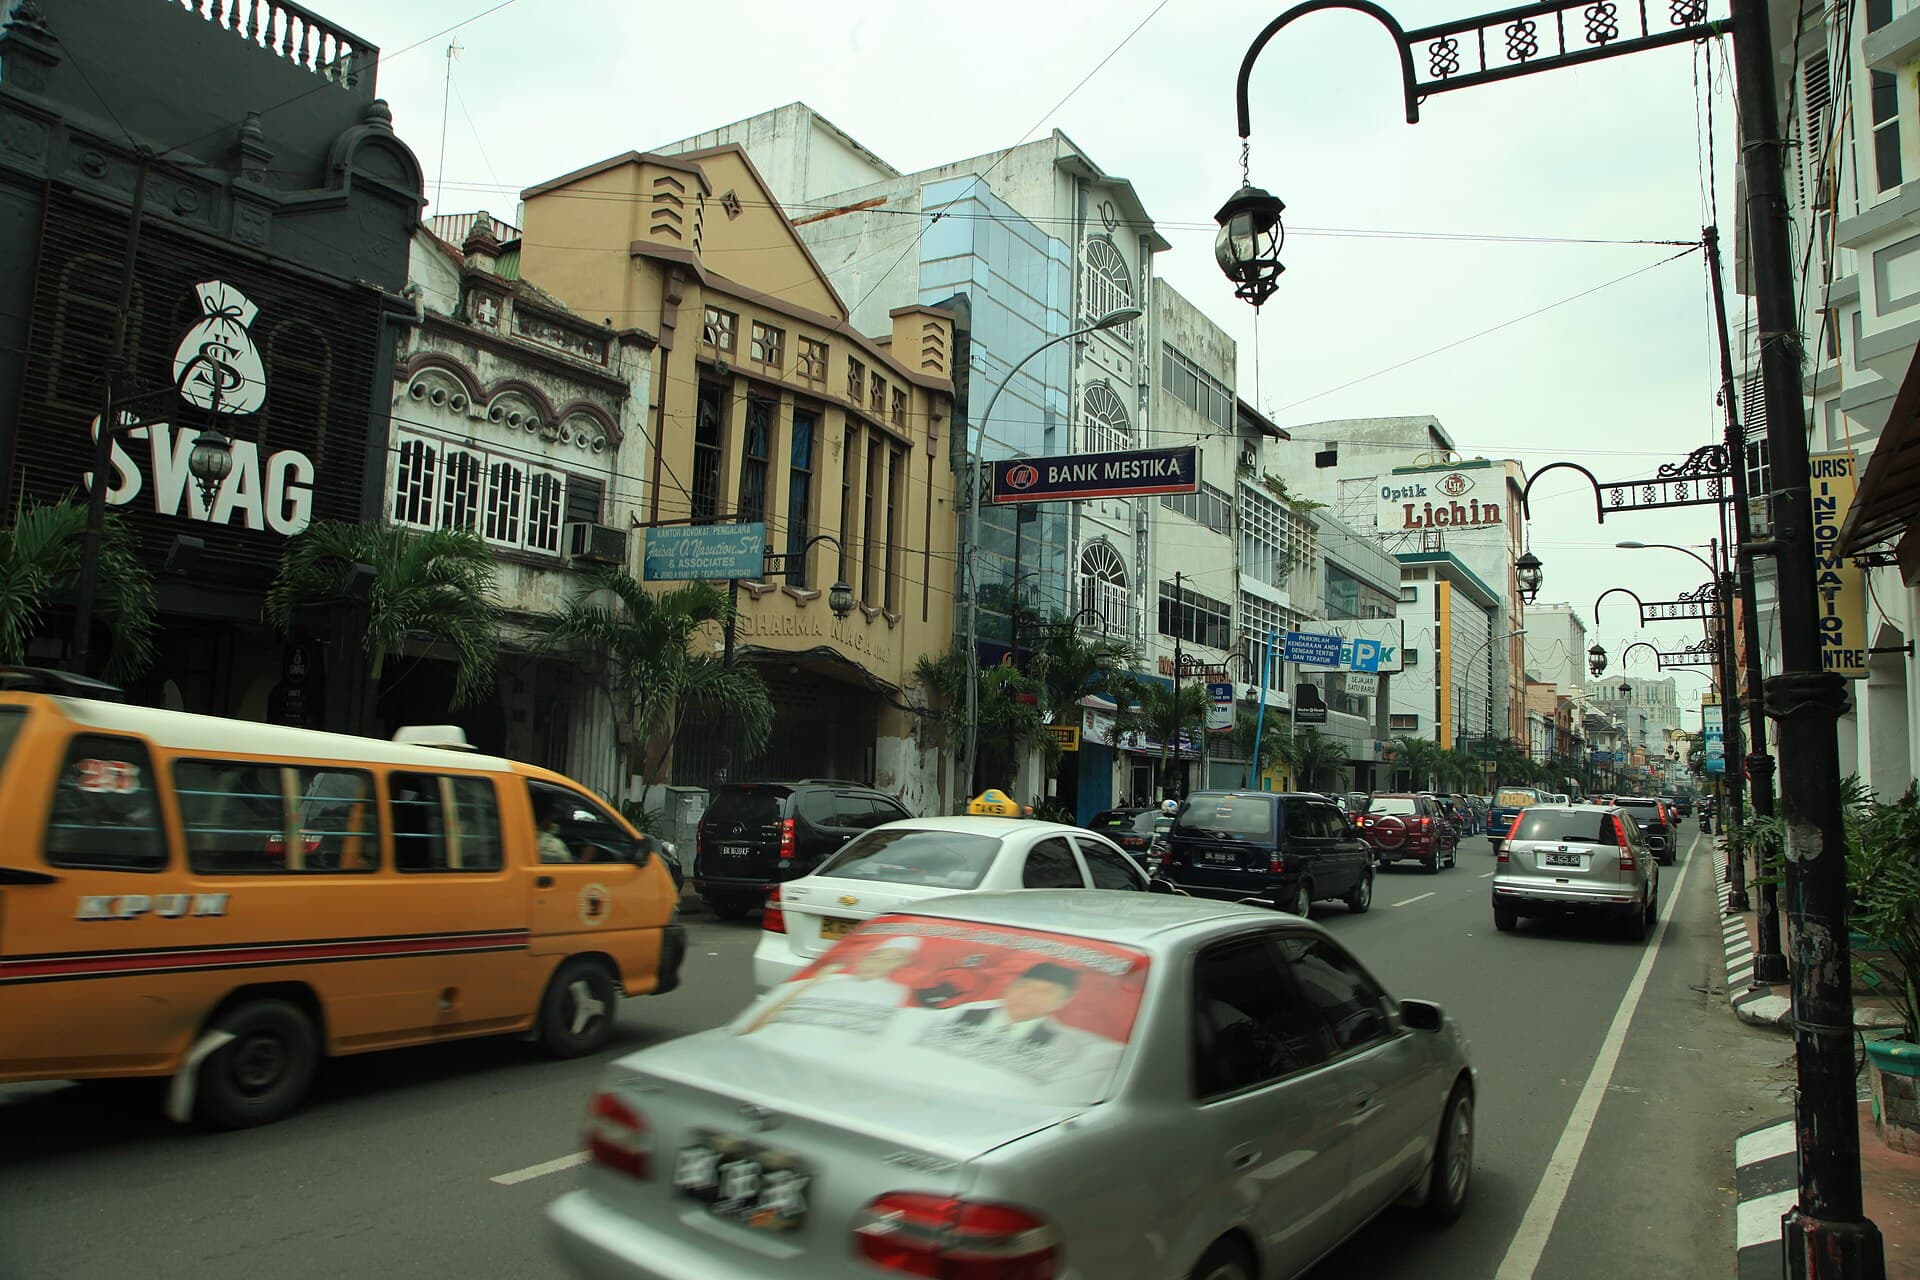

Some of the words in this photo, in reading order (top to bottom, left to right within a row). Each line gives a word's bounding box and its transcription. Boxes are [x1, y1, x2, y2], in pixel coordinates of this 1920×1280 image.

[84, 410, 315, 536] SWAG
[1048, 463, 1099, 484] BANK
[1103, 457, 1181, 480] MESTIKA
[1810, 458, 1855, 478] URIST
[1381, 484, 1427, 503] Optik
[1403, 499, 1502, 529] Lichin
[657, 528, 681, 538] KANTOR
[679, 557, 736, 568] ASSOCIATES
[743, 613, 823, 637] DHARMA
[1287, 641, 1322, 650] KENDARAAN
[1298, 635, 1330, 644] PARKIRLAH
[1291, 647, 1314, 656] DENGAN
[1356, 643, 1376, 666] P
[1822, 649, 1865, 669] NTRE
